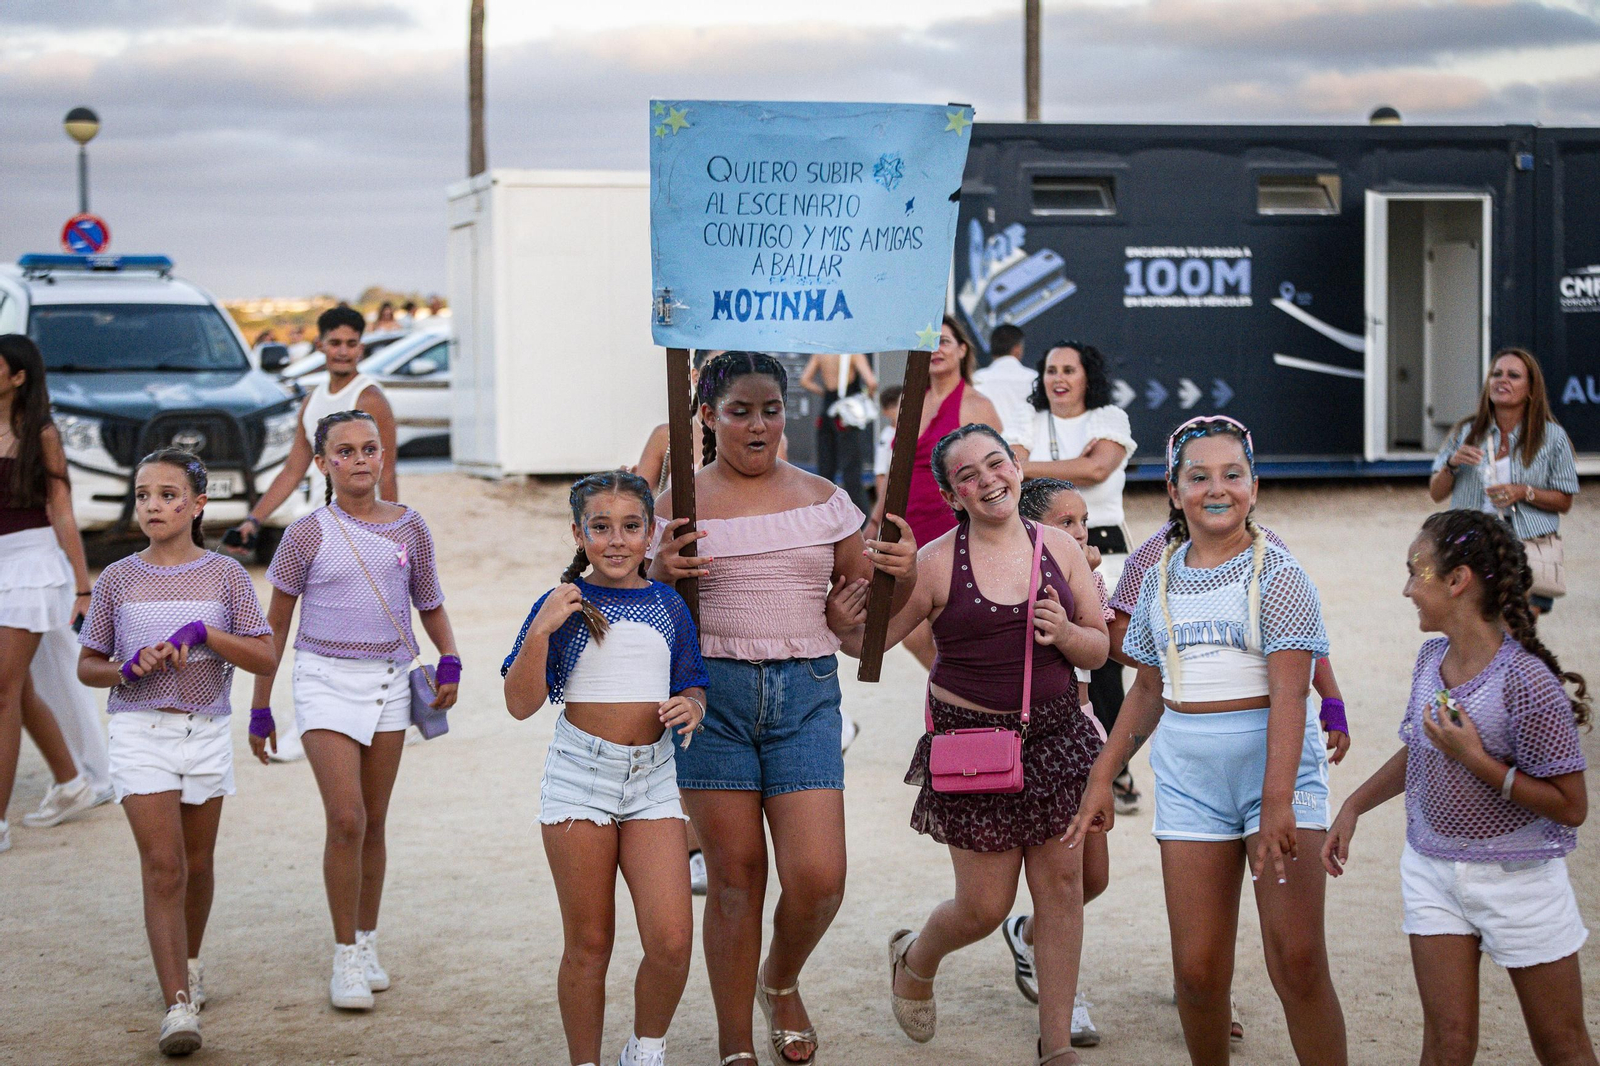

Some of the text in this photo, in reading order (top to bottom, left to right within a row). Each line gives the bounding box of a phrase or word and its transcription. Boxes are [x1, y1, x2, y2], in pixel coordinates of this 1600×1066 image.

[706, 155, 864, 184] QUIERO SUBIR
[705, 192, 861, 218] AL ESCENARIO
[703, 222, 923, 252] CONTIGO Y MIS AMIGAS
[752, 253, 842, 277] A BAILAR
[1124, 258, 1252, 296] 100M
[711, 288, 854, 322] MOTINHA
